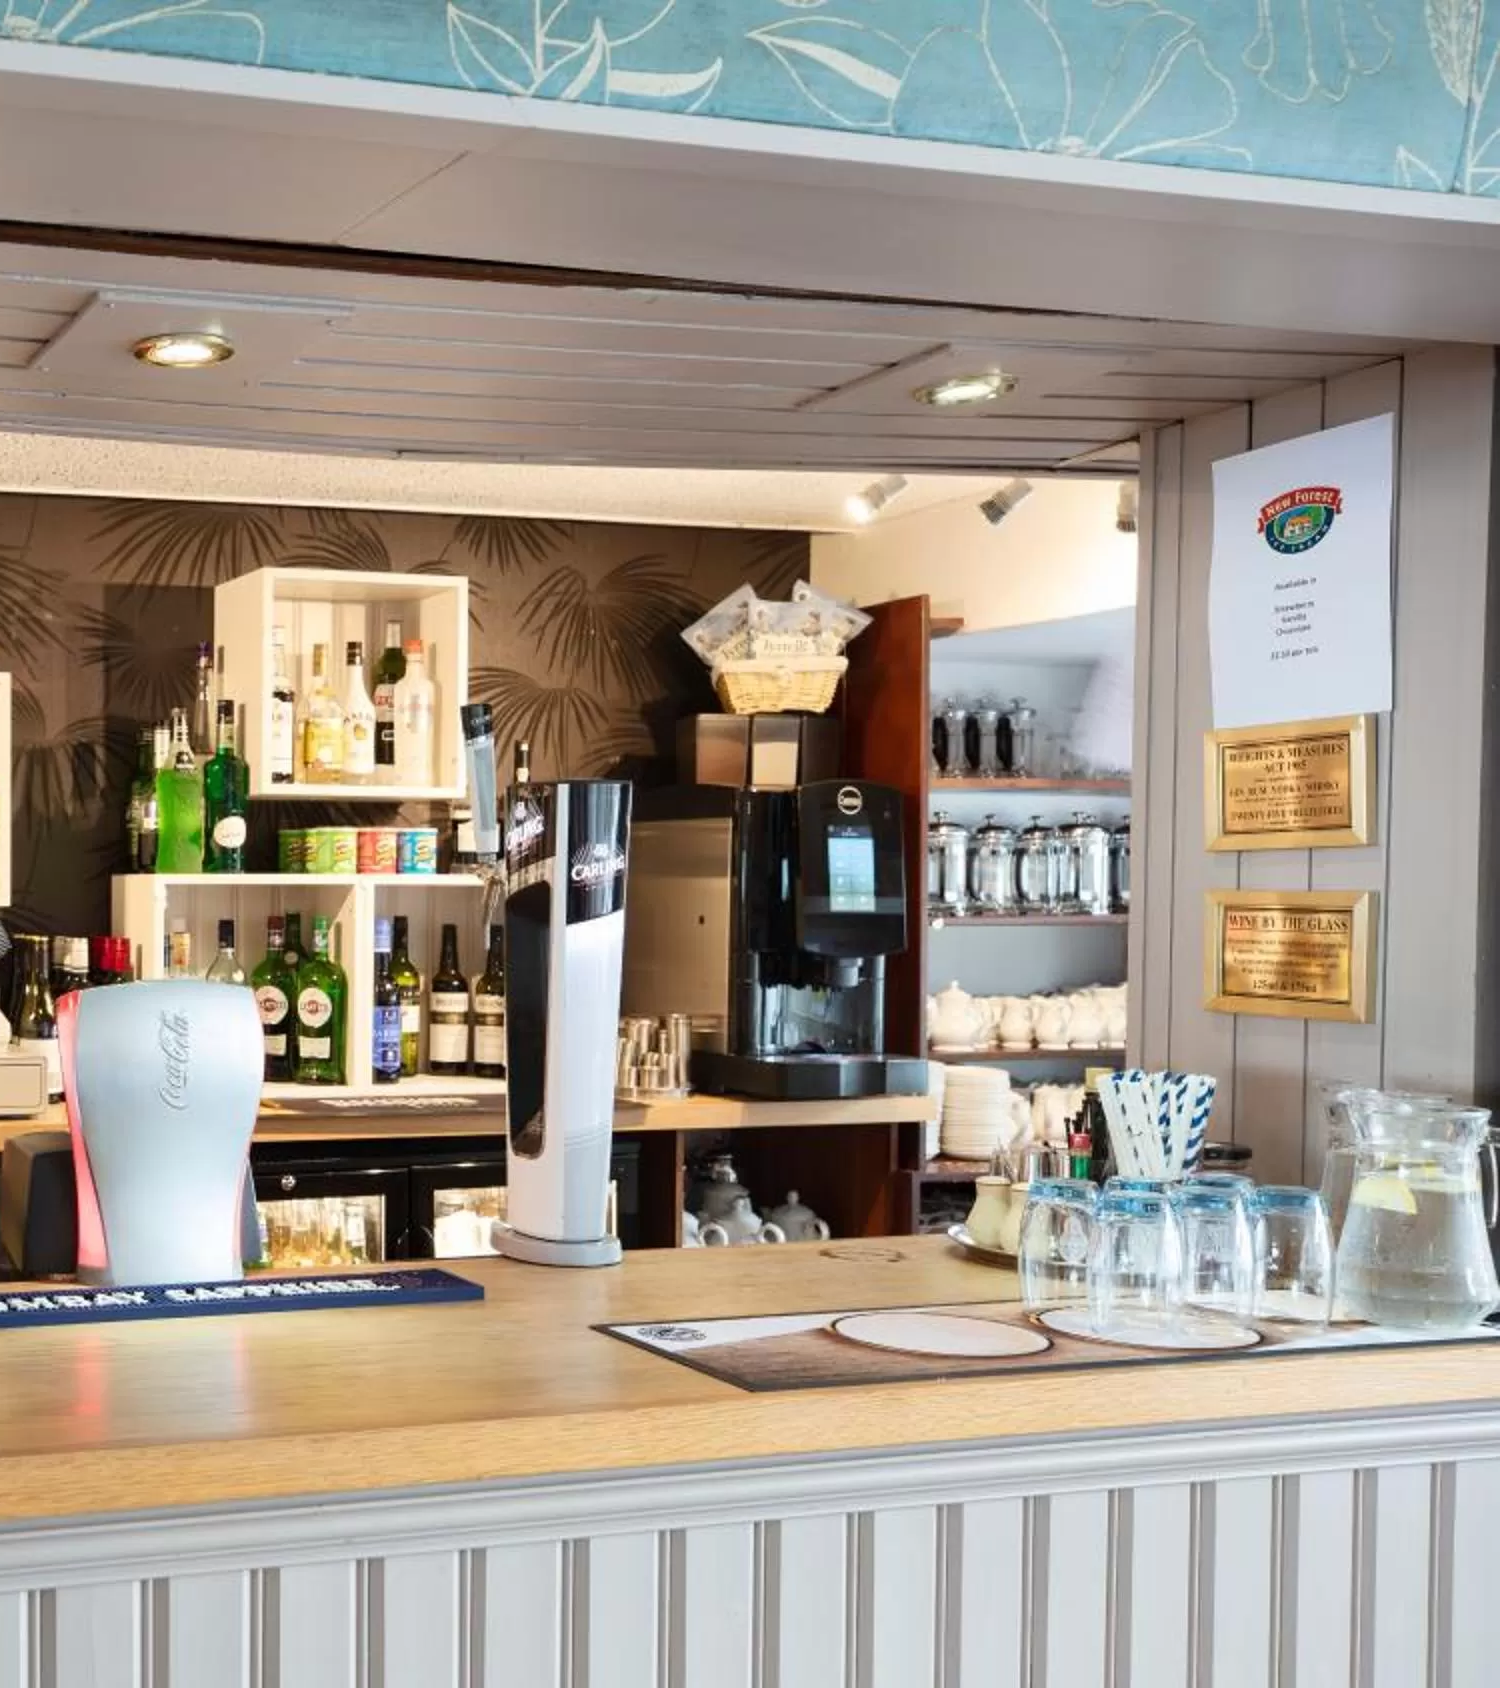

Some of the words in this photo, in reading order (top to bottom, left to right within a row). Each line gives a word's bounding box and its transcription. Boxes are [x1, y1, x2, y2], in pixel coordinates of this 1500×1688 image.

[1265, 497, 1291, 516] New
[1295, 489, 1334, 504] Forest
[1287, 741, 1346, 758] MEASURES
[571, 853, 626, 881] CARLING
[1228, 914, 1257, 927] WINE
[1261, 916, 1276, 928] BY
[1283, 916, 1304, 929] THE
[1307, 917, 1349, 932] GLASS
[158, 1009, 191, 1112] Coca-Cola
